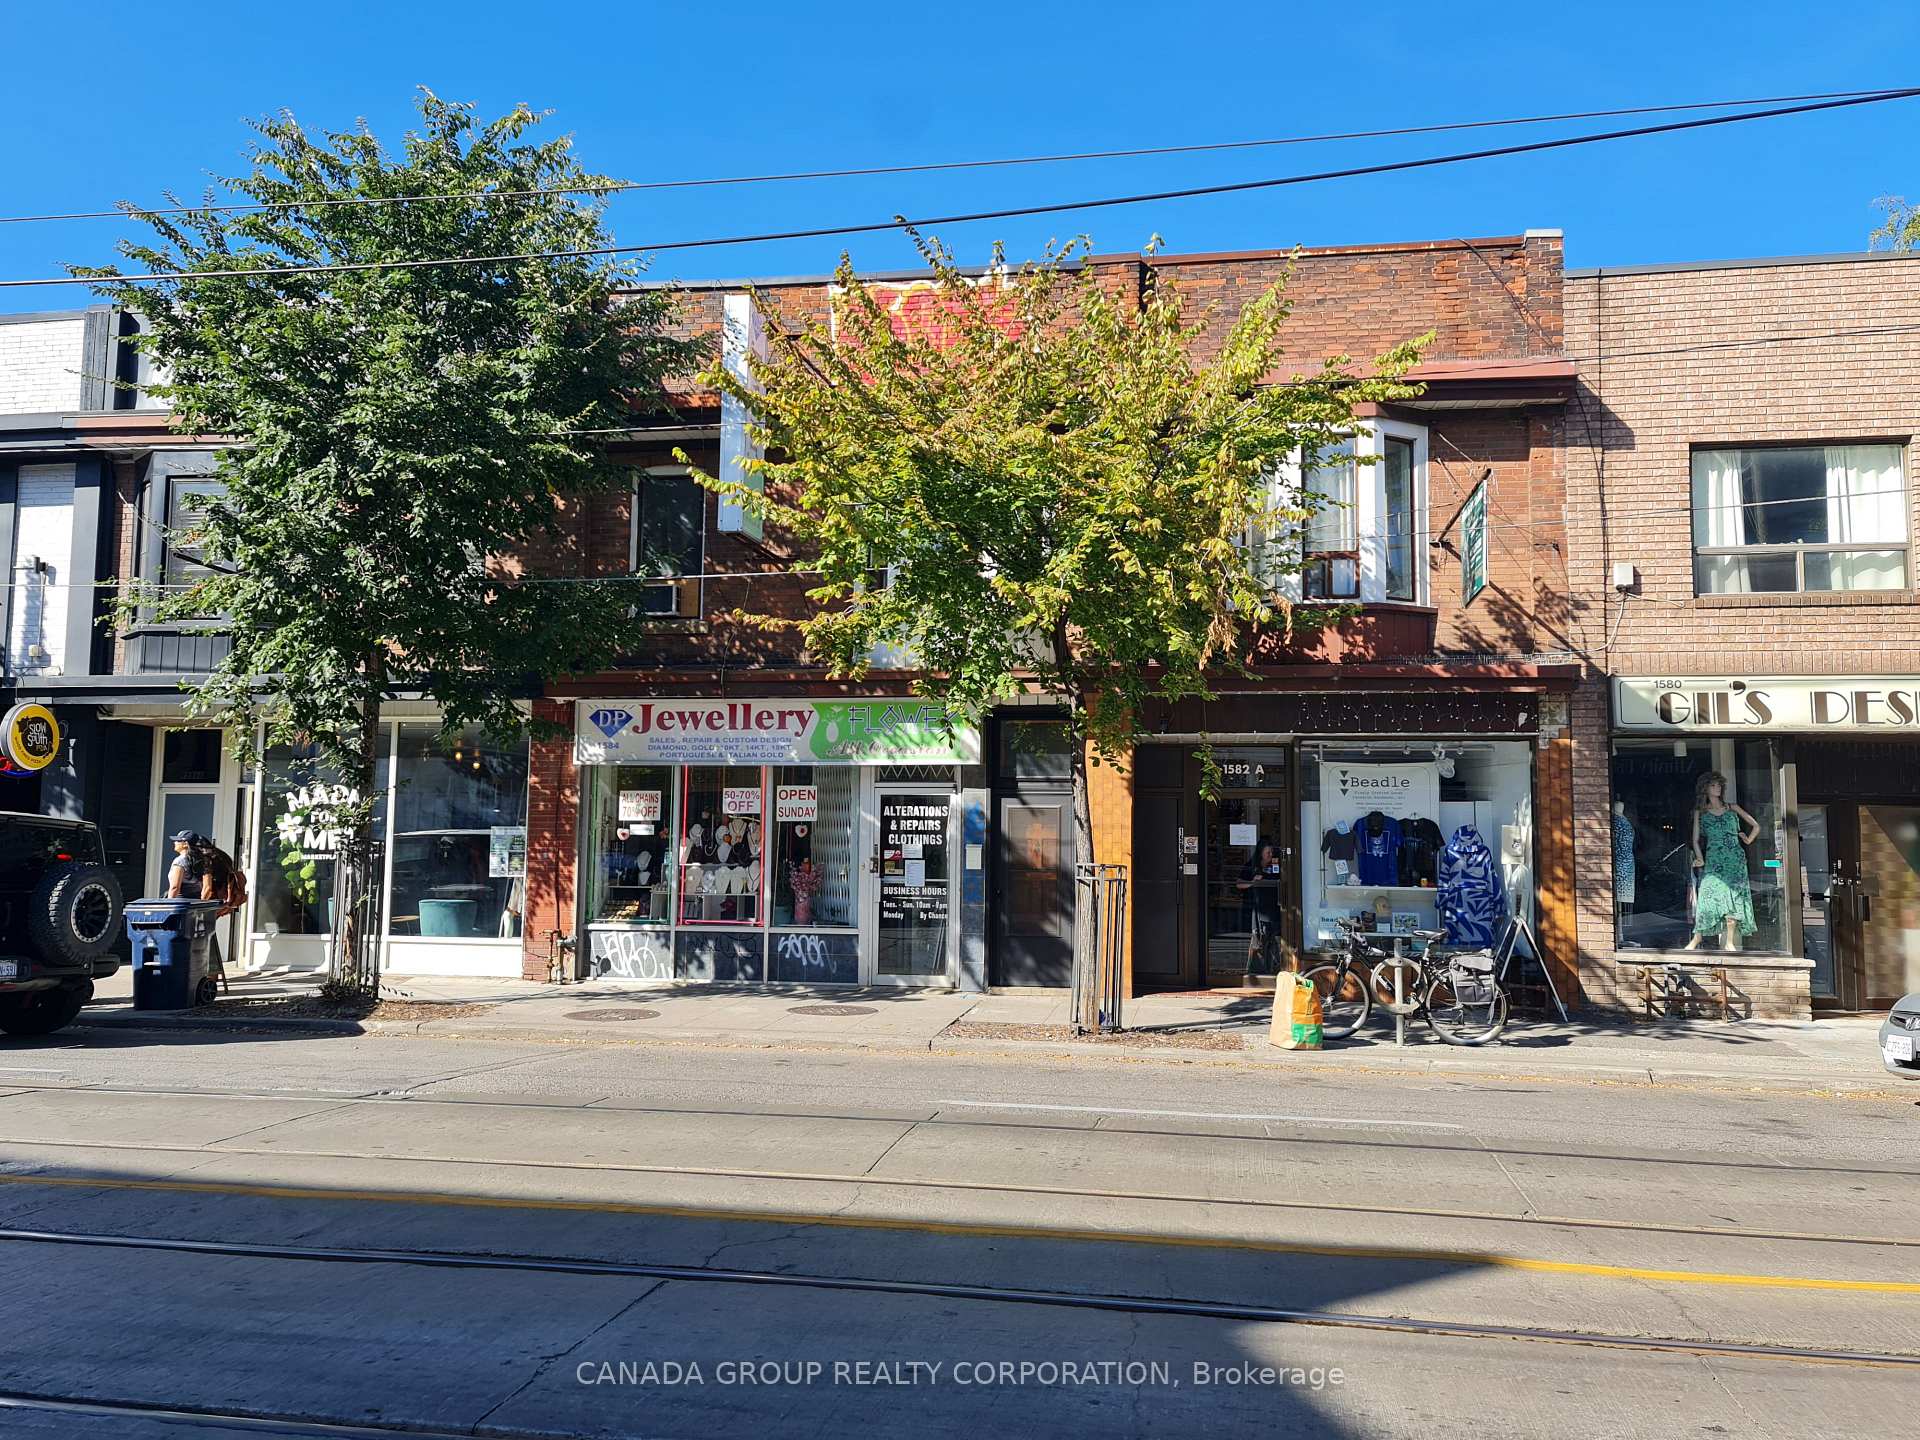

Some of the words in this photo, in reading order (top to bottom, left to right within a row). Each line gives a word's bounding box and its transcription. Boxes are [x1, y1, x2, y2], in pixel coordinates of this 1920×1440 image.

[1653, 679, 1682, 689] 1580
[1655, 680, 1773, 725] GIL'S
[1810, 690, 1920, 725] DES
[598, 710, 626, 727] DP
[632, 703, 814, 738] Jewellery
[597, 742, 619, 750] 1584
[1222, 764, 1250, 775] 1582
[1254, 764, 1265, 775] A
[1350, 776, 1410, 788] Beadle
[635, 792, 659, 803] CHAINS
[724, 790, 760, 800] 50-70%
[778, 789, 816, 801] OPEN
[640, 806, 658, 818] OFF
[727, 800, 755, 812] OFF
[778, 806, 815, 818] SUNDAY
[883, 805, 949, 817] ALTERATIONS
[890, 820, 898, 831] &
[900, 820, 941, 831] REPAIRS
[888, 833, 943, 845] CLOTHINGS
[883, 886, 920, 896] BUSINESS
[921, 887, 947, 896] HOURS
[883, 911, 904, 920] Monday
[920, 912, 928, 920] By
